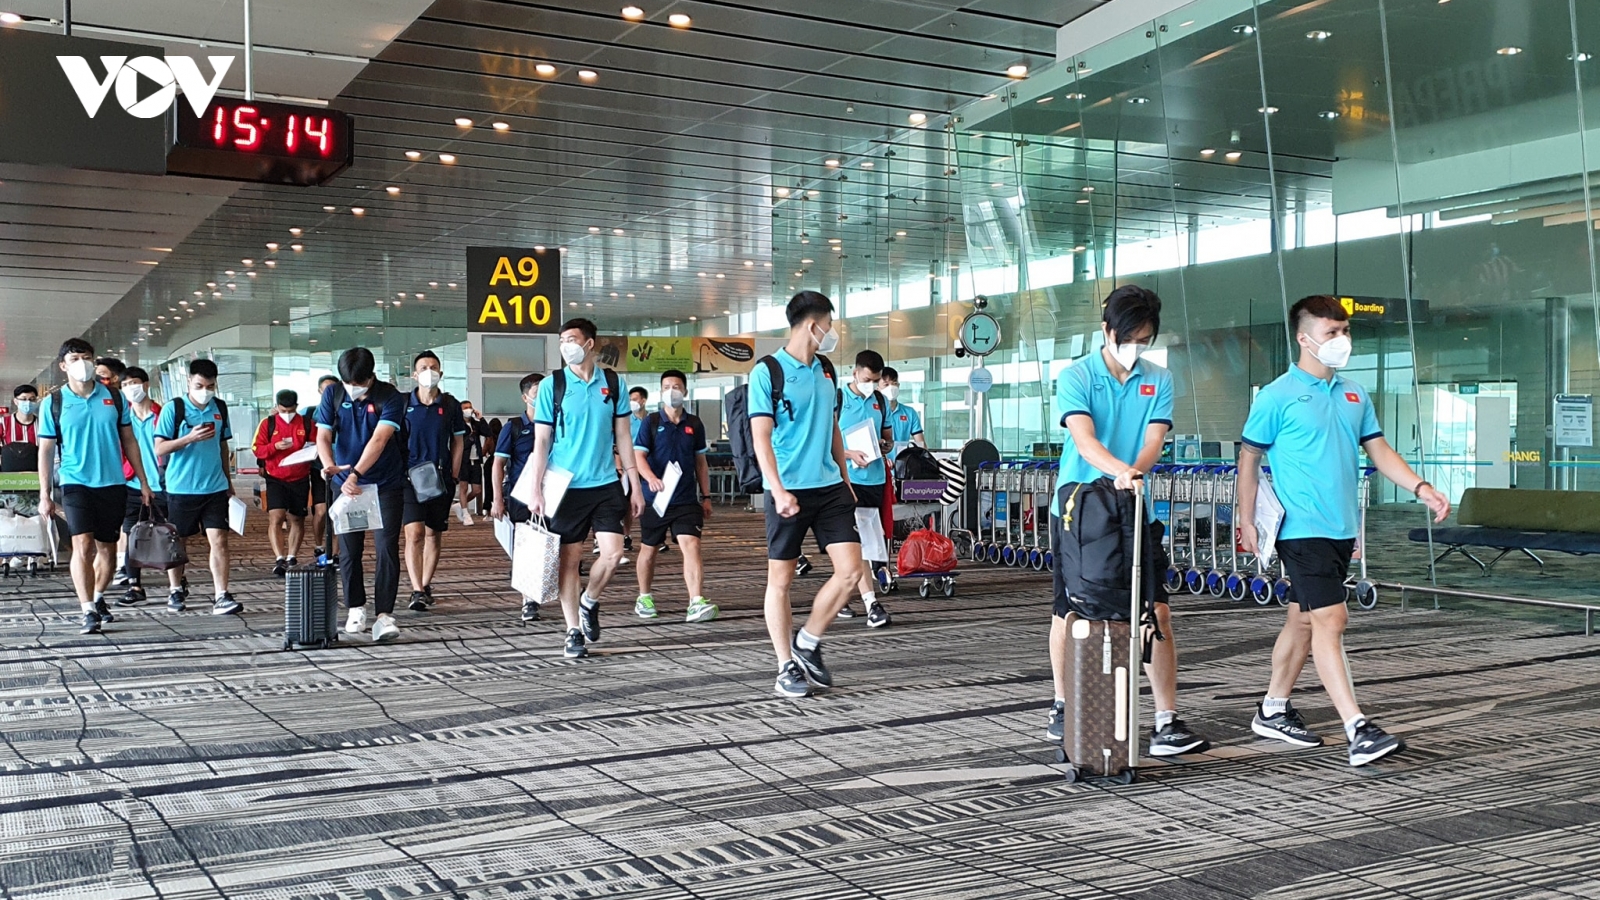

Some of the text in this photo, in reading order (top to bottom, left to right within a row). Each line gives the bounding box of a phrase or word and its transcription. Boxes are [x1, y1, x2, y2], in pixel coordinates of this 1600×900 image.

[489, 257, 539, 286] A9
[478, 295, 551, 325] A10
[1354, 302, 1384, 314] Boarding
